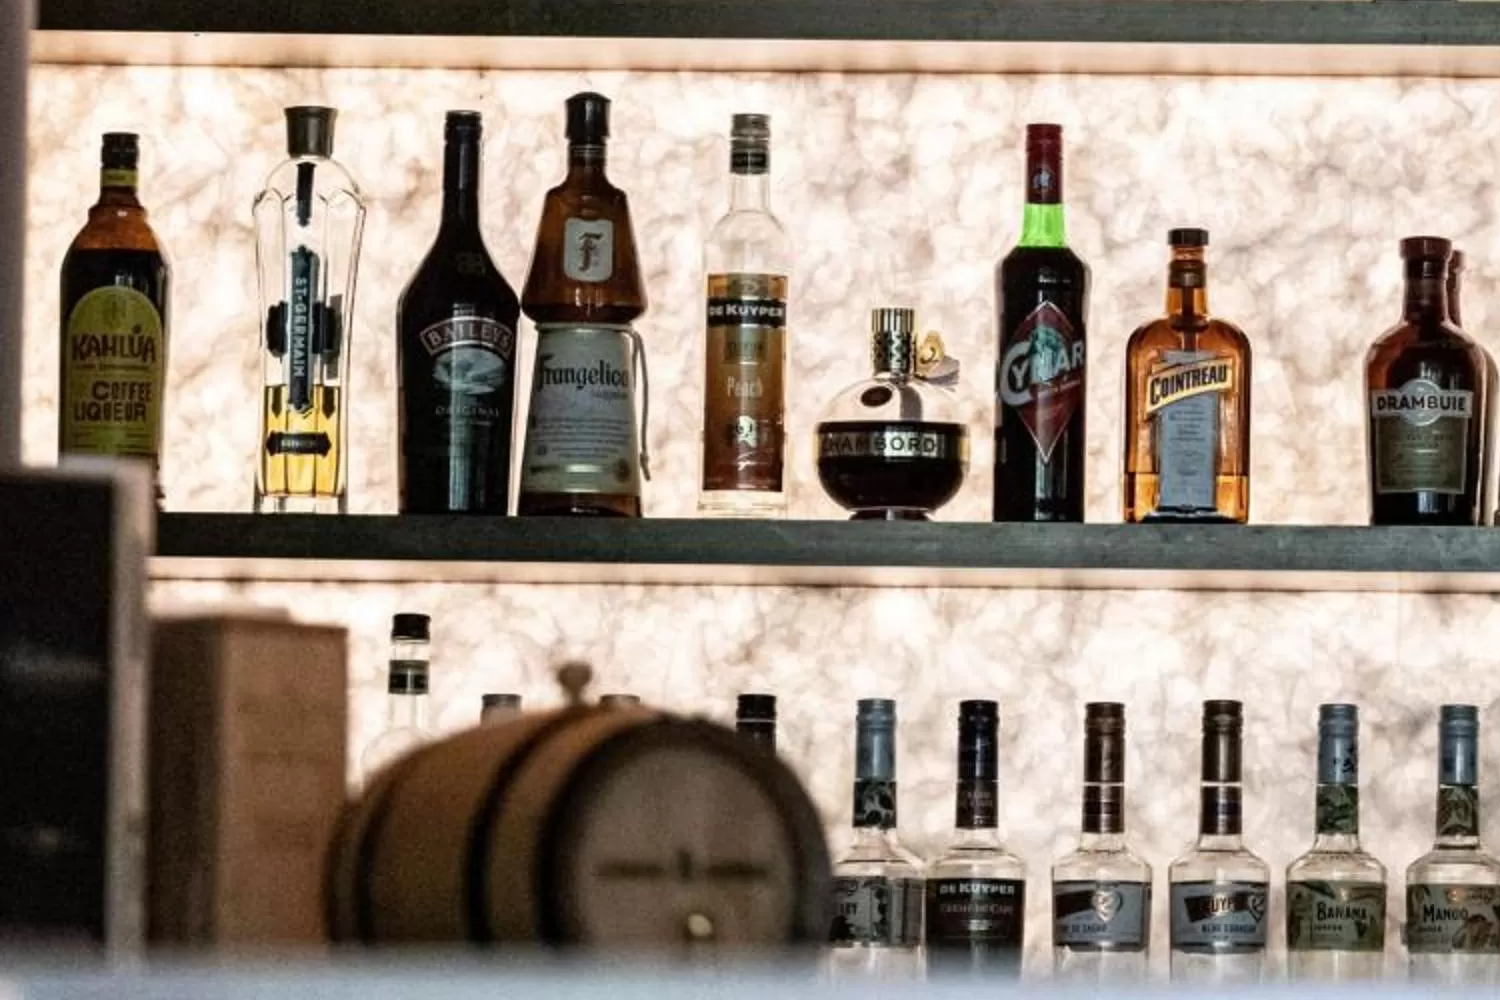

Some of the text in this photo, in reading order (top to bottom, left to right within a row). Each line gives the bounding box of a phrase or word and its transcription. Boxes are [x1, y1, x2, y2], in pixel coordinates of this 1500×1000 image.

[71, 324, 157, 364] KAHLÚA
[429, 320, 511, 348] BAILEYS
[91, 379, 153, 402] COFFEE
[1150, 364, 1228, 406] COINTREAU
[73, 400, 148, 424] LIQUEUR
[1376, 394, 1467, 412] DRAMBUIE
[1316, 901, 1367, 922] BANANA
[1422, 903, 1470, 923] MANGO
